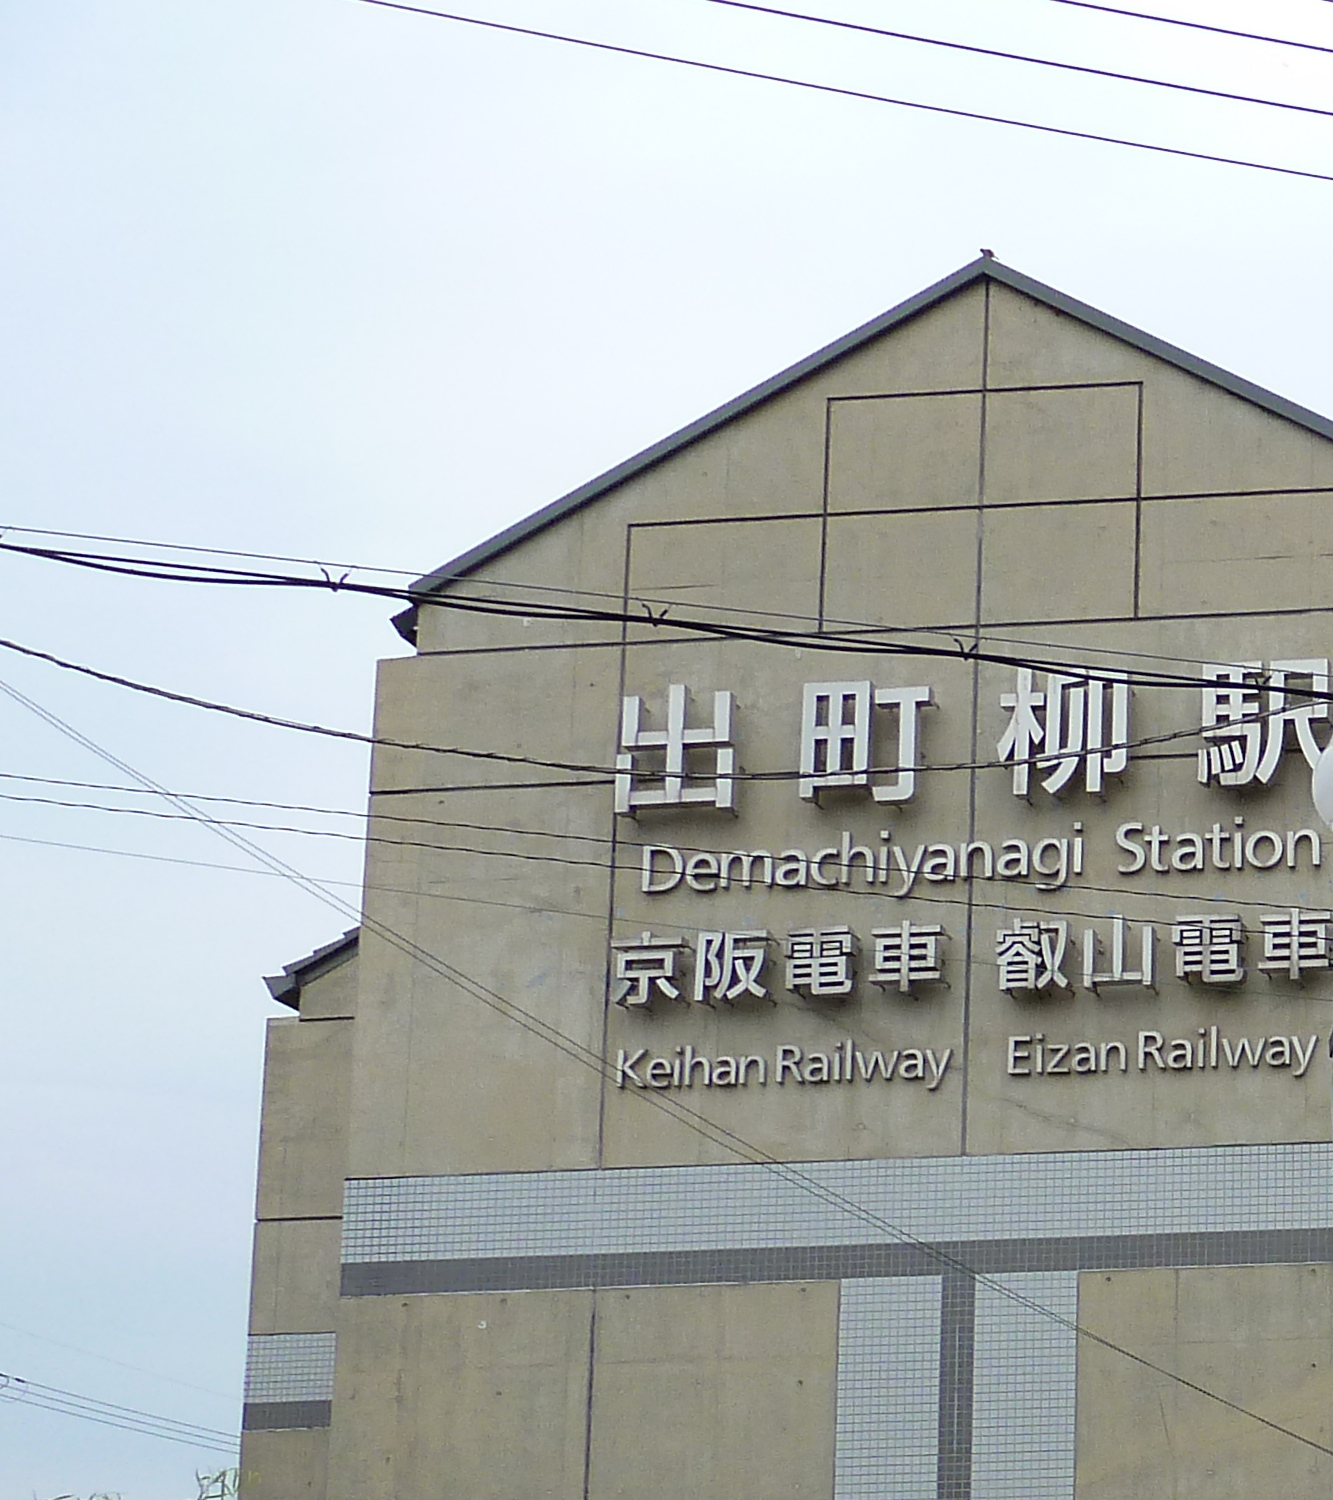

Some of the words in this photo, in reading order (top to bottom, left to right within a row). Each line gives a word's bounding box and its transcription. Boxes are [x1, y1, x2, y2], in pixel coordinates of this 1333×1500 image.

[614, 658, 1331, 815] 出町柳駅
[642, 823, 1083, 894] Demachiyanagi
[1117, 819, 1322, 875] Station
[613, 920, 945, 1006] 京阪電車
[996, 908, 1333, 993] 叡山電車
[617, 1047, 765, 1090] Keihan
[776, 1040, 952, 1090] Railway
[1007, 1034, 1125, 1076] Eizan
[1138, 1025, 1318, 1077] Railway
